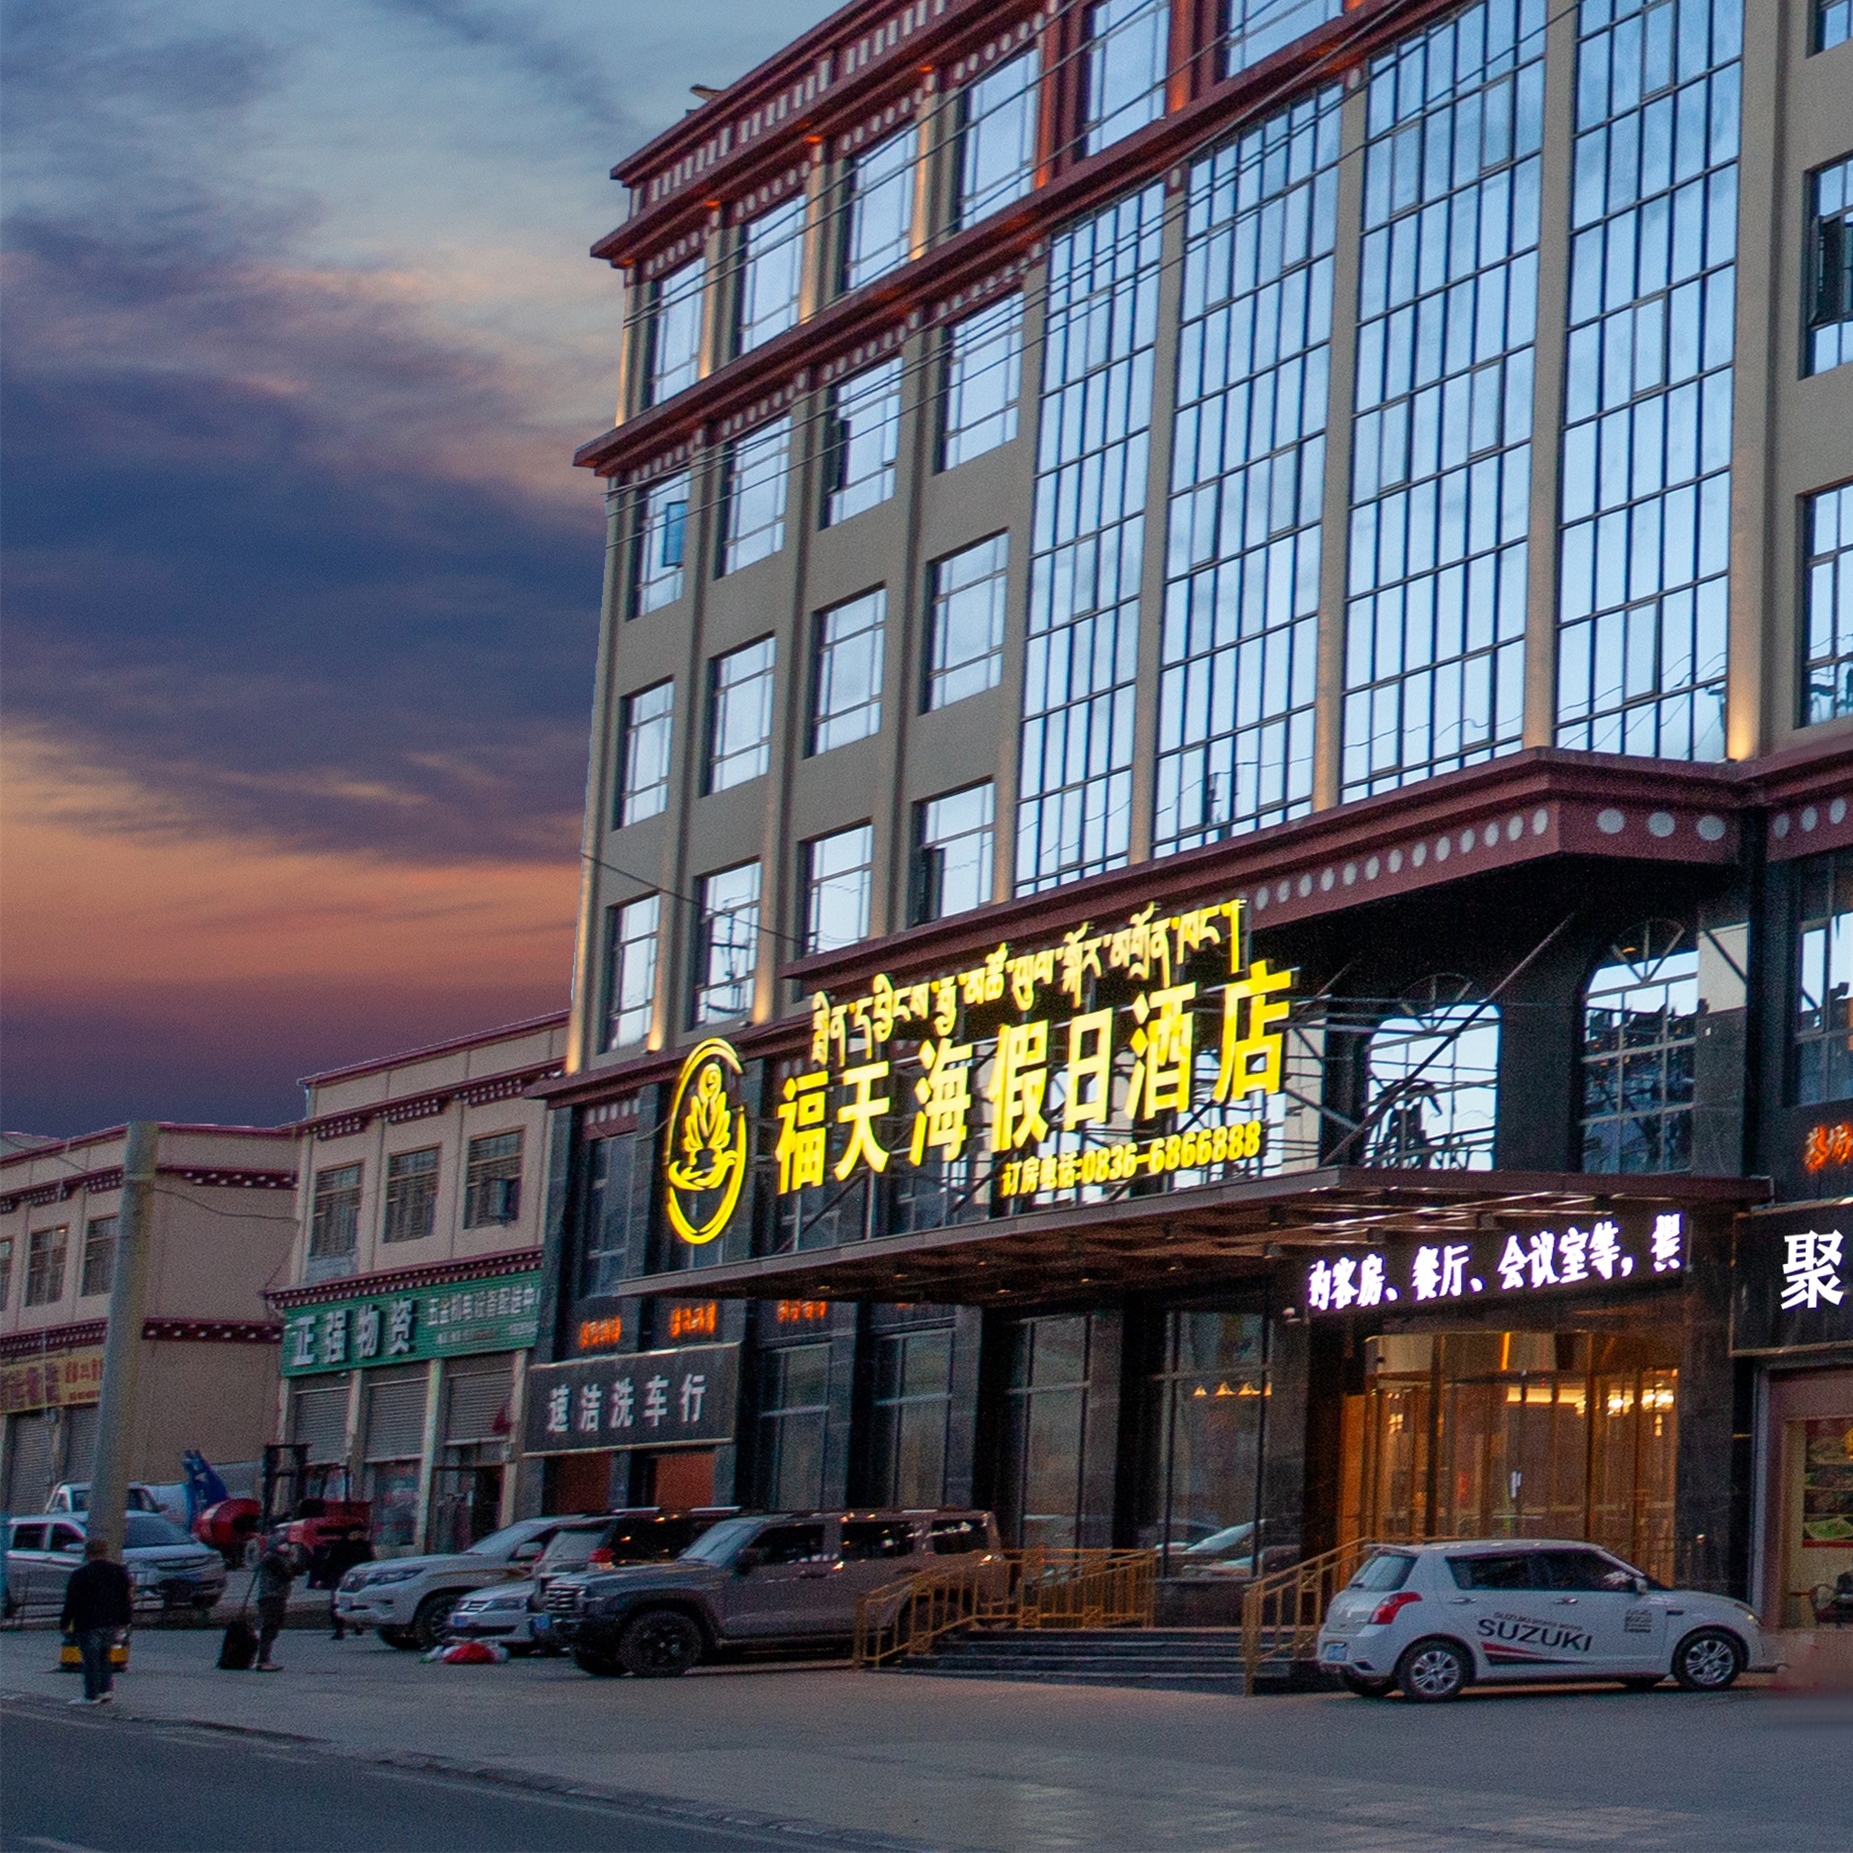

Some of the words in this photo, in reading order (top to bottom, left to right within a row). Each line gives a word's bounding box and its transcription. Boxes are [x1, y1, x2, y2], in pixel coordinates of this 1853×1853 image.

[774, 961, 1292, 1194] 福天海假日酒店
[1001, 1120, 1261, 1197] 订房电话:0836-6866888
[290, 1298, 415, 1366] 正强物资
[428, 1286, 541, 1325] 五金机电设备配送中
[1477, 1619, 1594, 1652] SUZUKI
